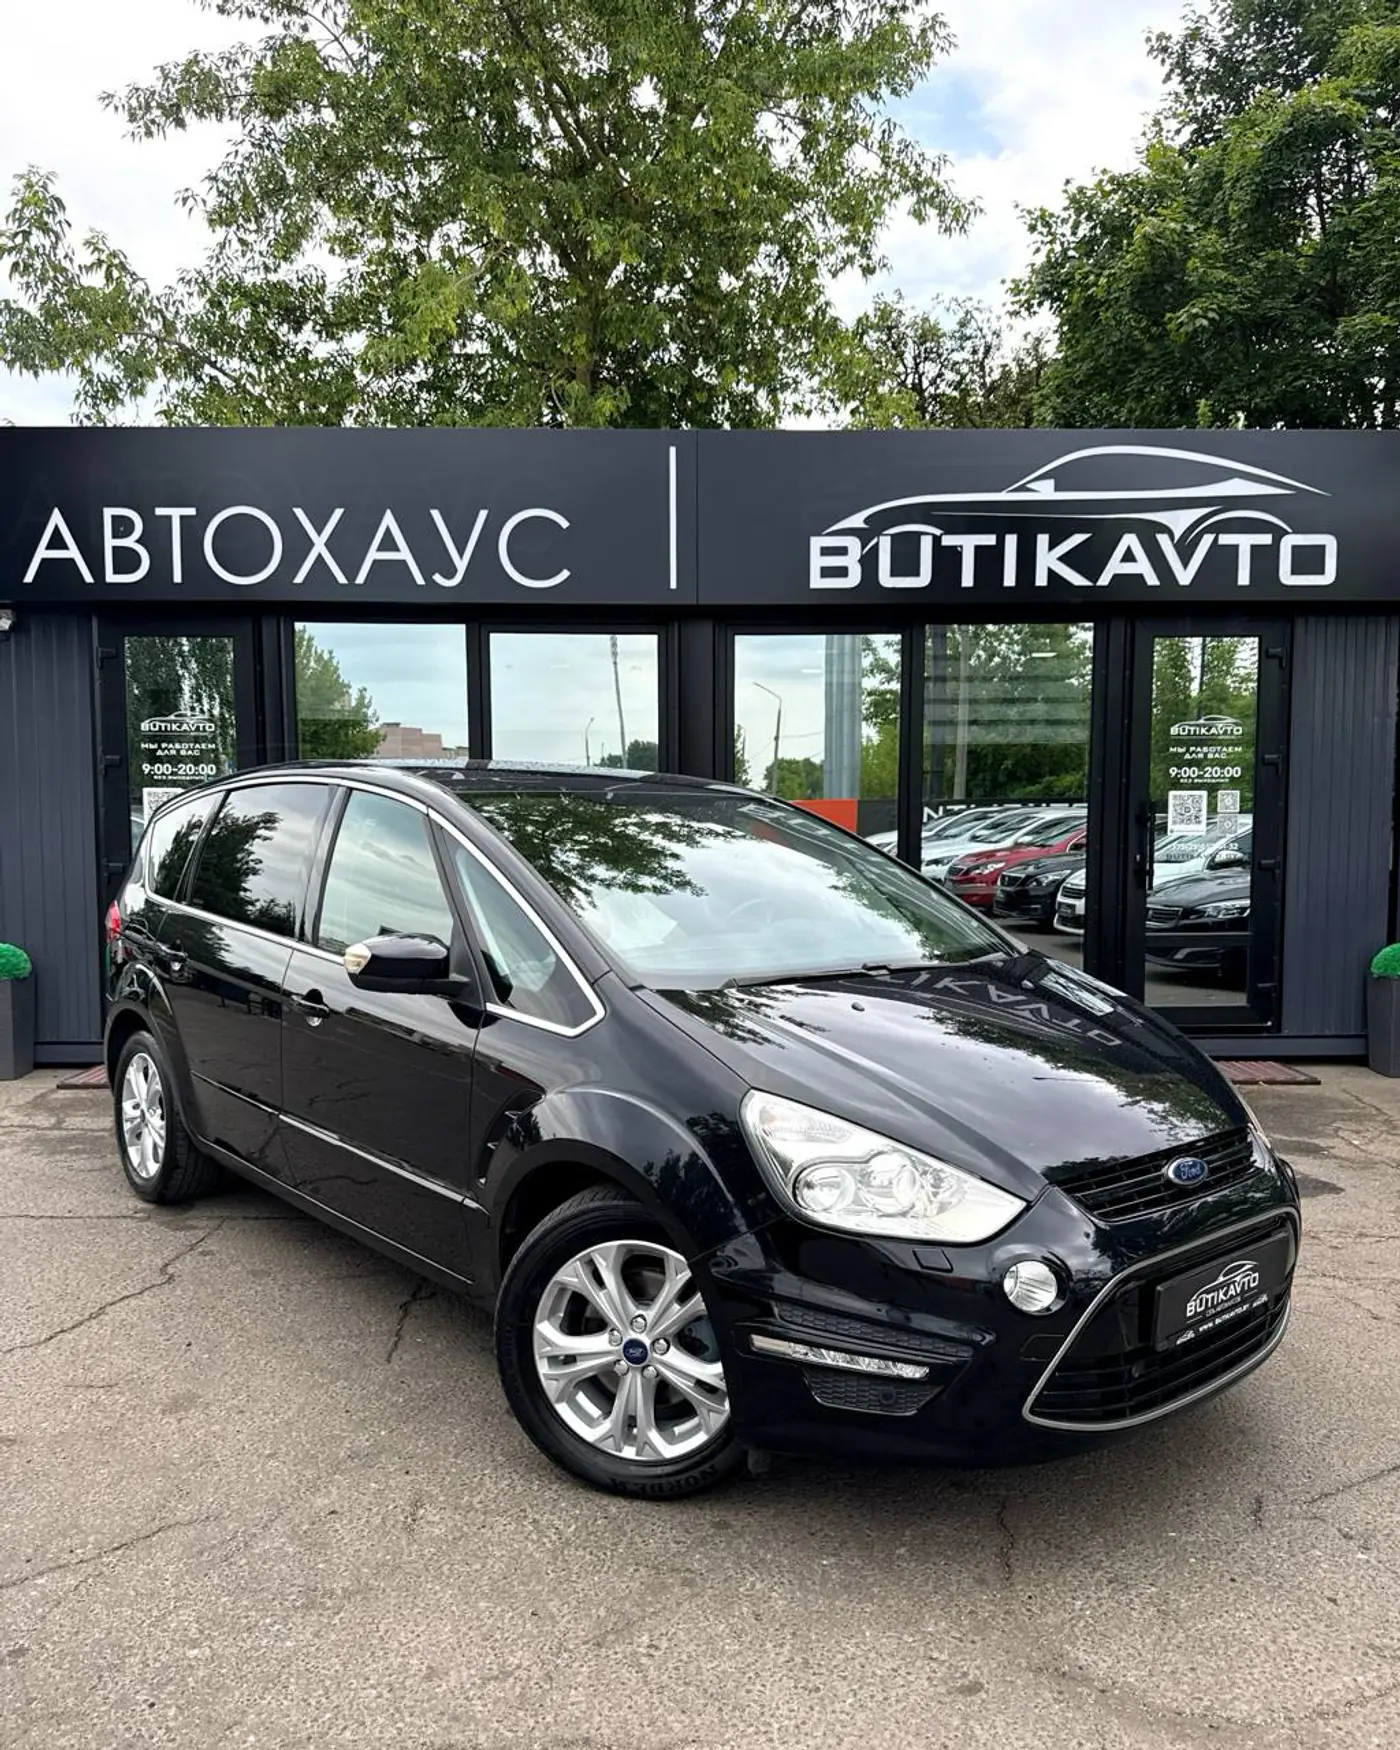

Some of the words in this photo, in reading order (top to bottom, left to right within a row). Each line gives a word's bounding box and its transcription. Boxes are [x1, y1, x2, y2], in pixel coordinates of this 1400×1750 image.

[23, 506, 571, 588] АВТОХАУС
[808, 532, 1338, 589] BUTIKAVTO
[140, 722, 215, 732] BUTIKAVTO
[1169, 726, 1243, 736] BUTIKAVTO
[1184, 752, 1204, 760] ДЛЯ
[142, 763, 216, 775] 9:00-20:00
[1169, 766, 1242, 778] 9:00-20:00
[1179, 1161, 1202, 1180] Ford
[1186, 1272, 1259, 1318] BUTIKAVTO
